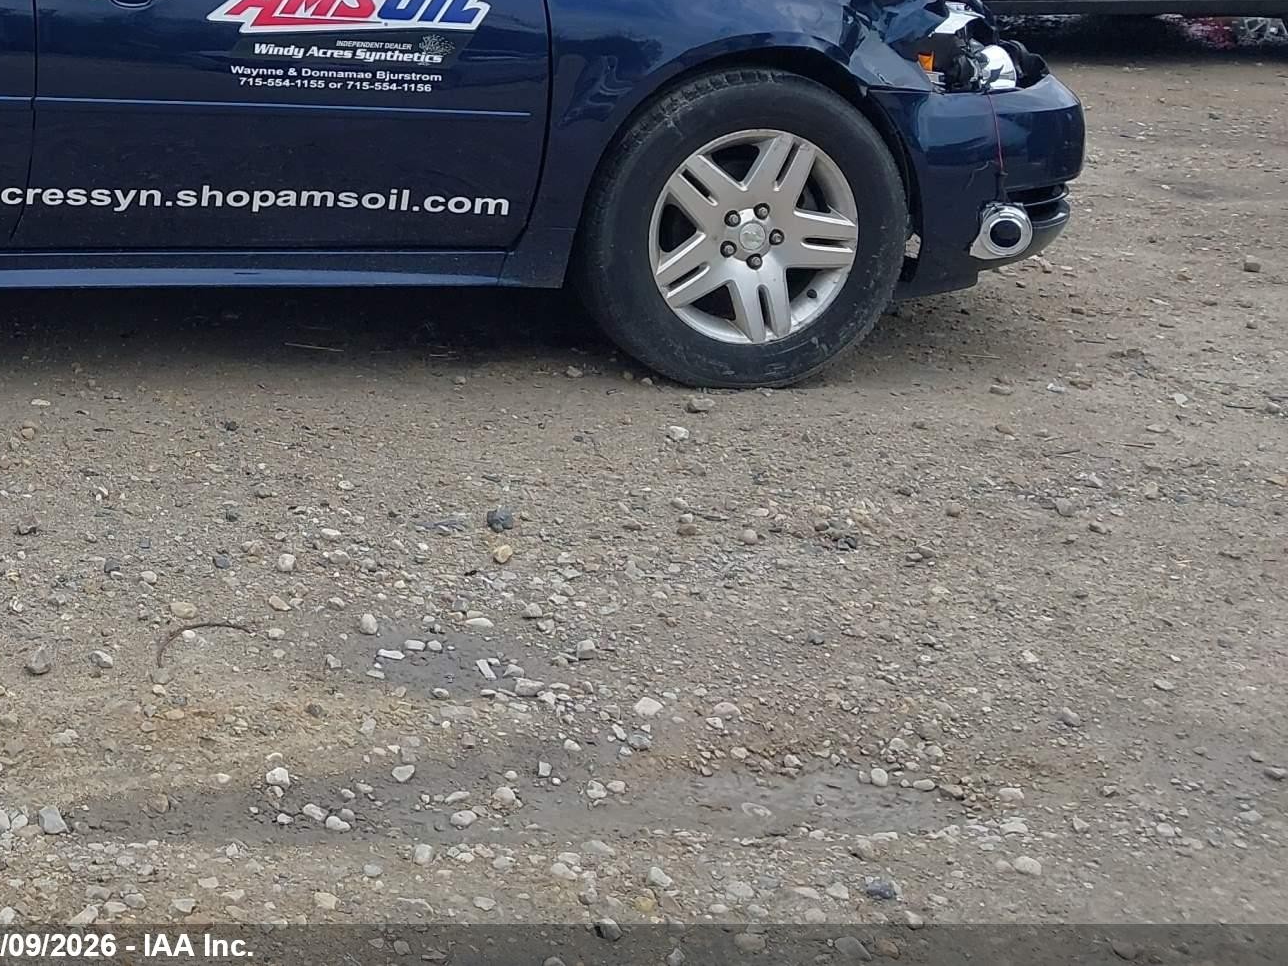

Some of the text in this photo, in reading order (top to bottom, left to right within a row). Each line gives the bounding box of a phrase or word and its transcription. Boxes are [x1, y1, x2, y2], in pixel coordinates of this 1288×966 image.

[336, 40, 412, 50] INDEPENDENT DEALER
[253, 43, 443, 63] Windy Acres Synthetics
[288, 67, 297, 76] &
[376, 70, 442, 81] Bjurstrom
[239, 77, 432, 92] 715-554-1155 or 715-554-1156
